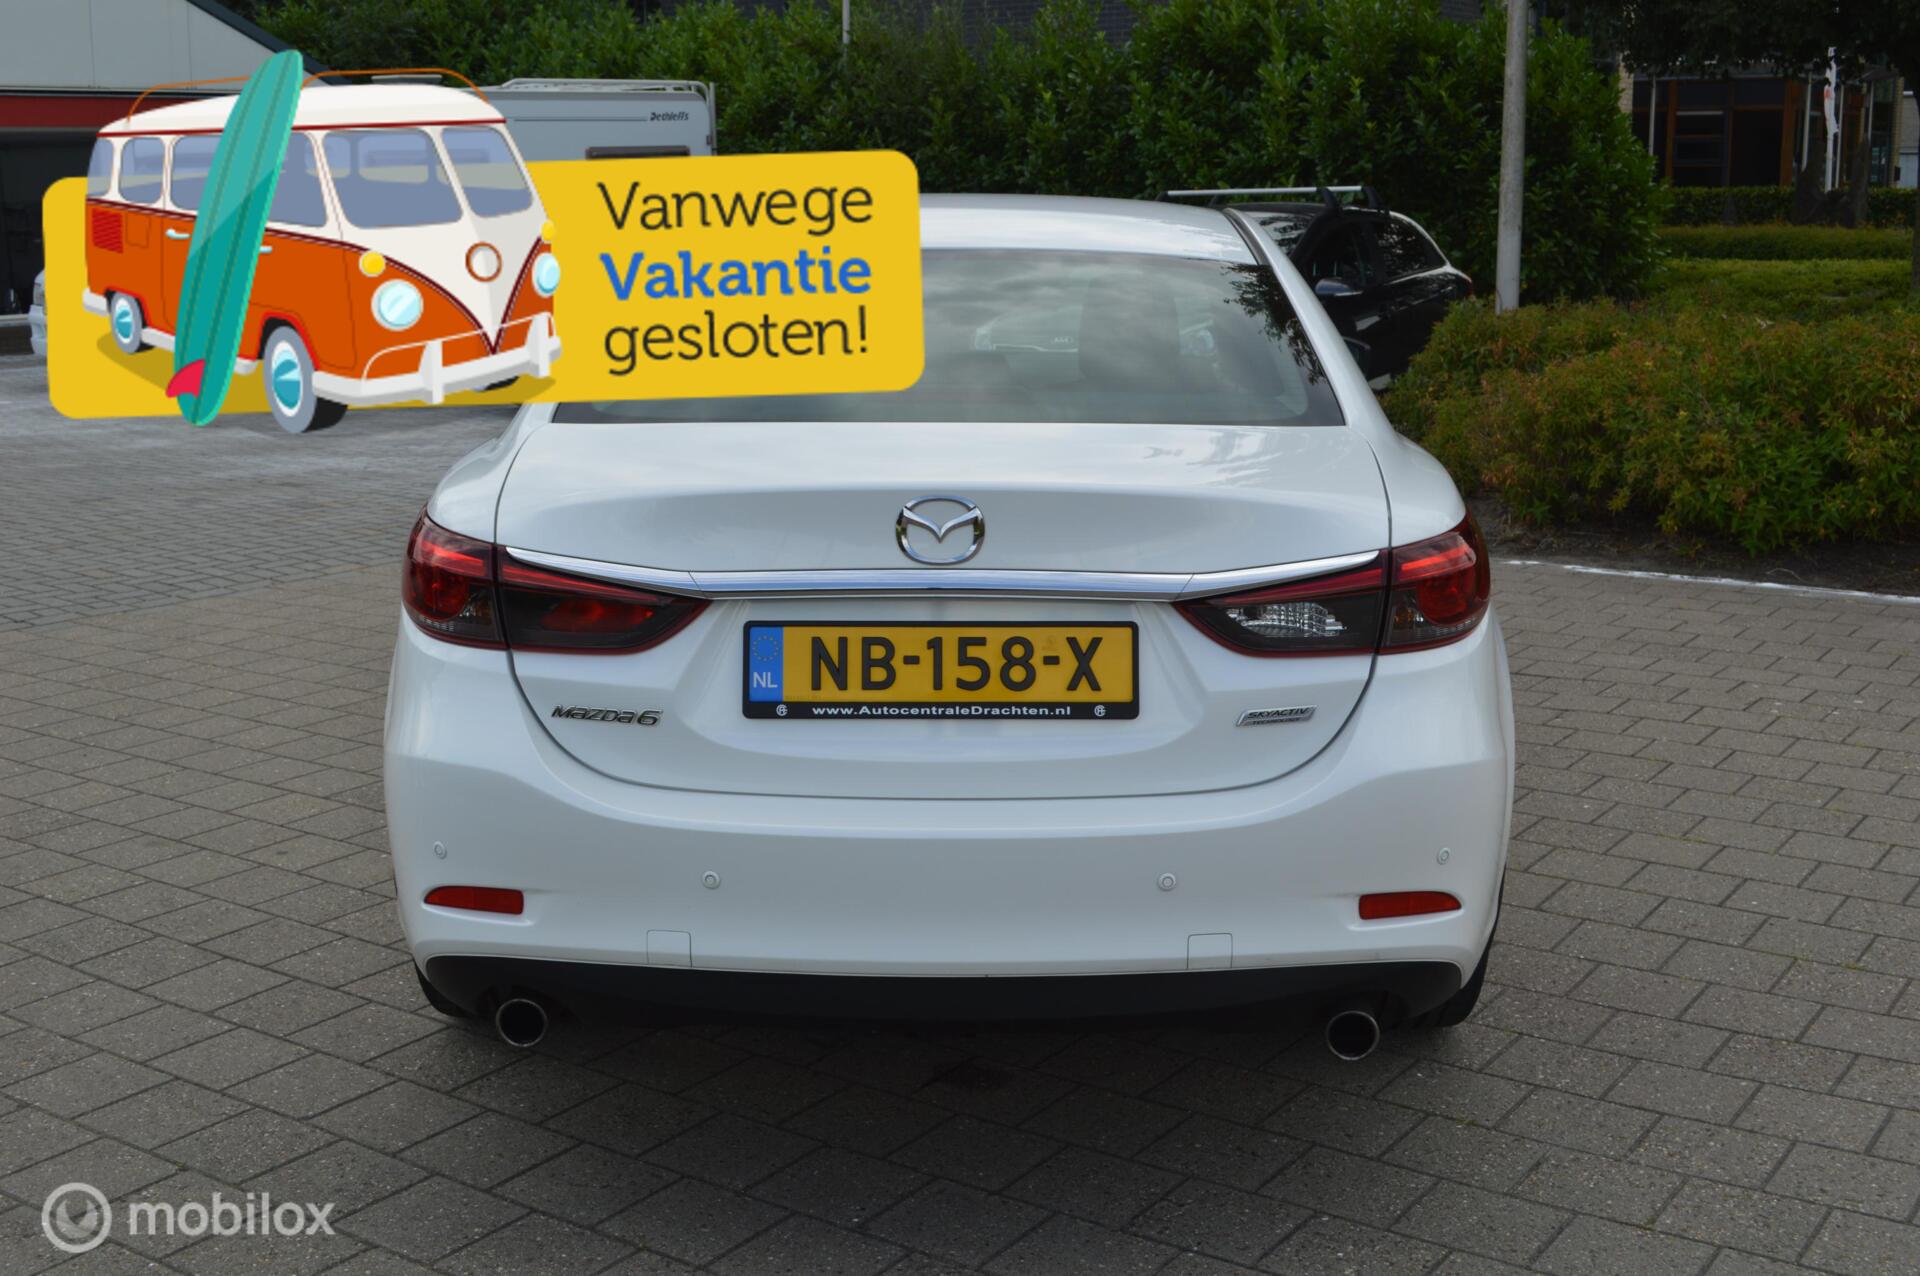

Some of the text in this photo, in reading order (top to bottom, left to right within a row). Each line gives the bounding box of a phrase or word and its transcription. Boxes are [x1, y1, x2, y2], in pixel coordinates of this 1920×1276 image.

[811, 636, 1103, 692] NB-158-X
[753, 672, 778, 688] NL
[812, 705, 1071, 717] www.AutocentraleDrachten.nl
[1247, 707, 1309, 719] SKYACTIV
